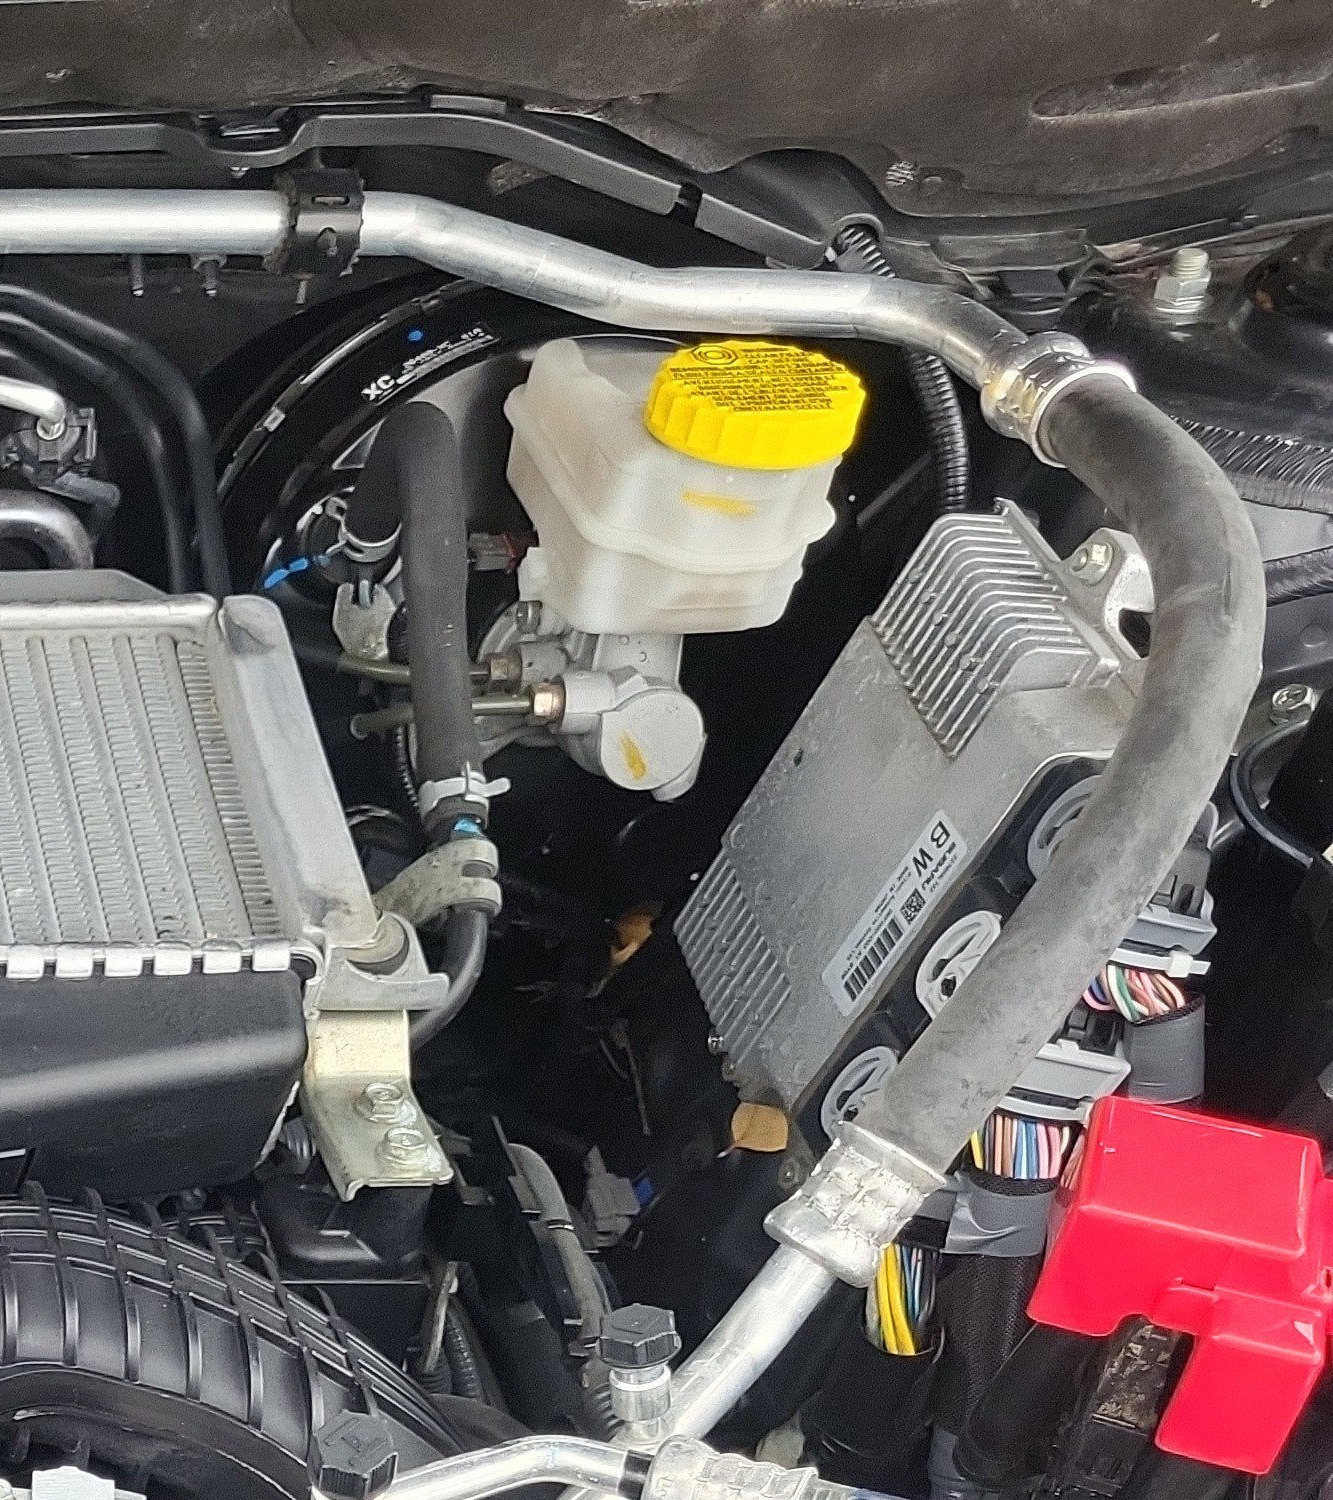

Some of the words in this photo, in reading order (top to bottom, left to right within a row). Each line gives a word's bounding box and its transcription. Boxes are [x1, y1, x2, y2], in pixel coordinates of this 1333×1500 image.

[361, 374, 396, 401] XC
[930, 820, 951, 849] B
[912, 847, 934, 878] W
